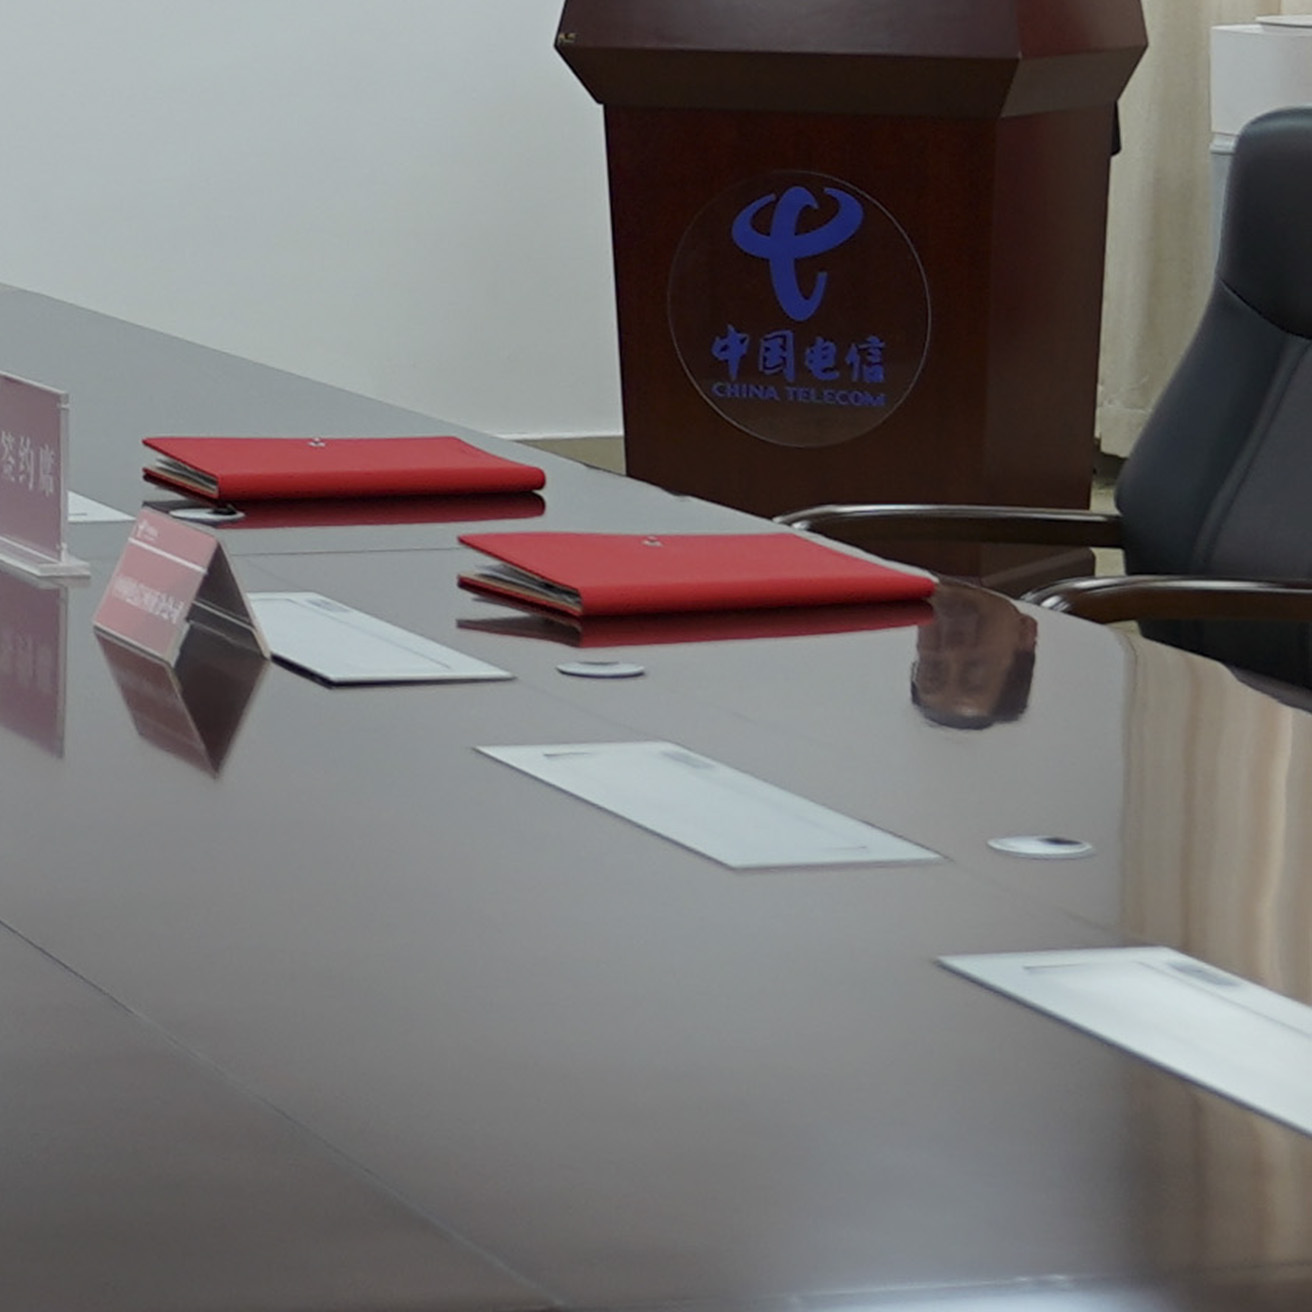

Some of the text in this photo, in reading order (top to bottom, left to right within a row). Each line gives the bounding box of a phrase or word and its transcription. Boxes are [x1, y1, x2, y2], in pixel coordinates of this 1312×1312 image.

[710, 324, 886, 383] 中国电信
[711, 382, 887, 407] CHINA TELECOM
